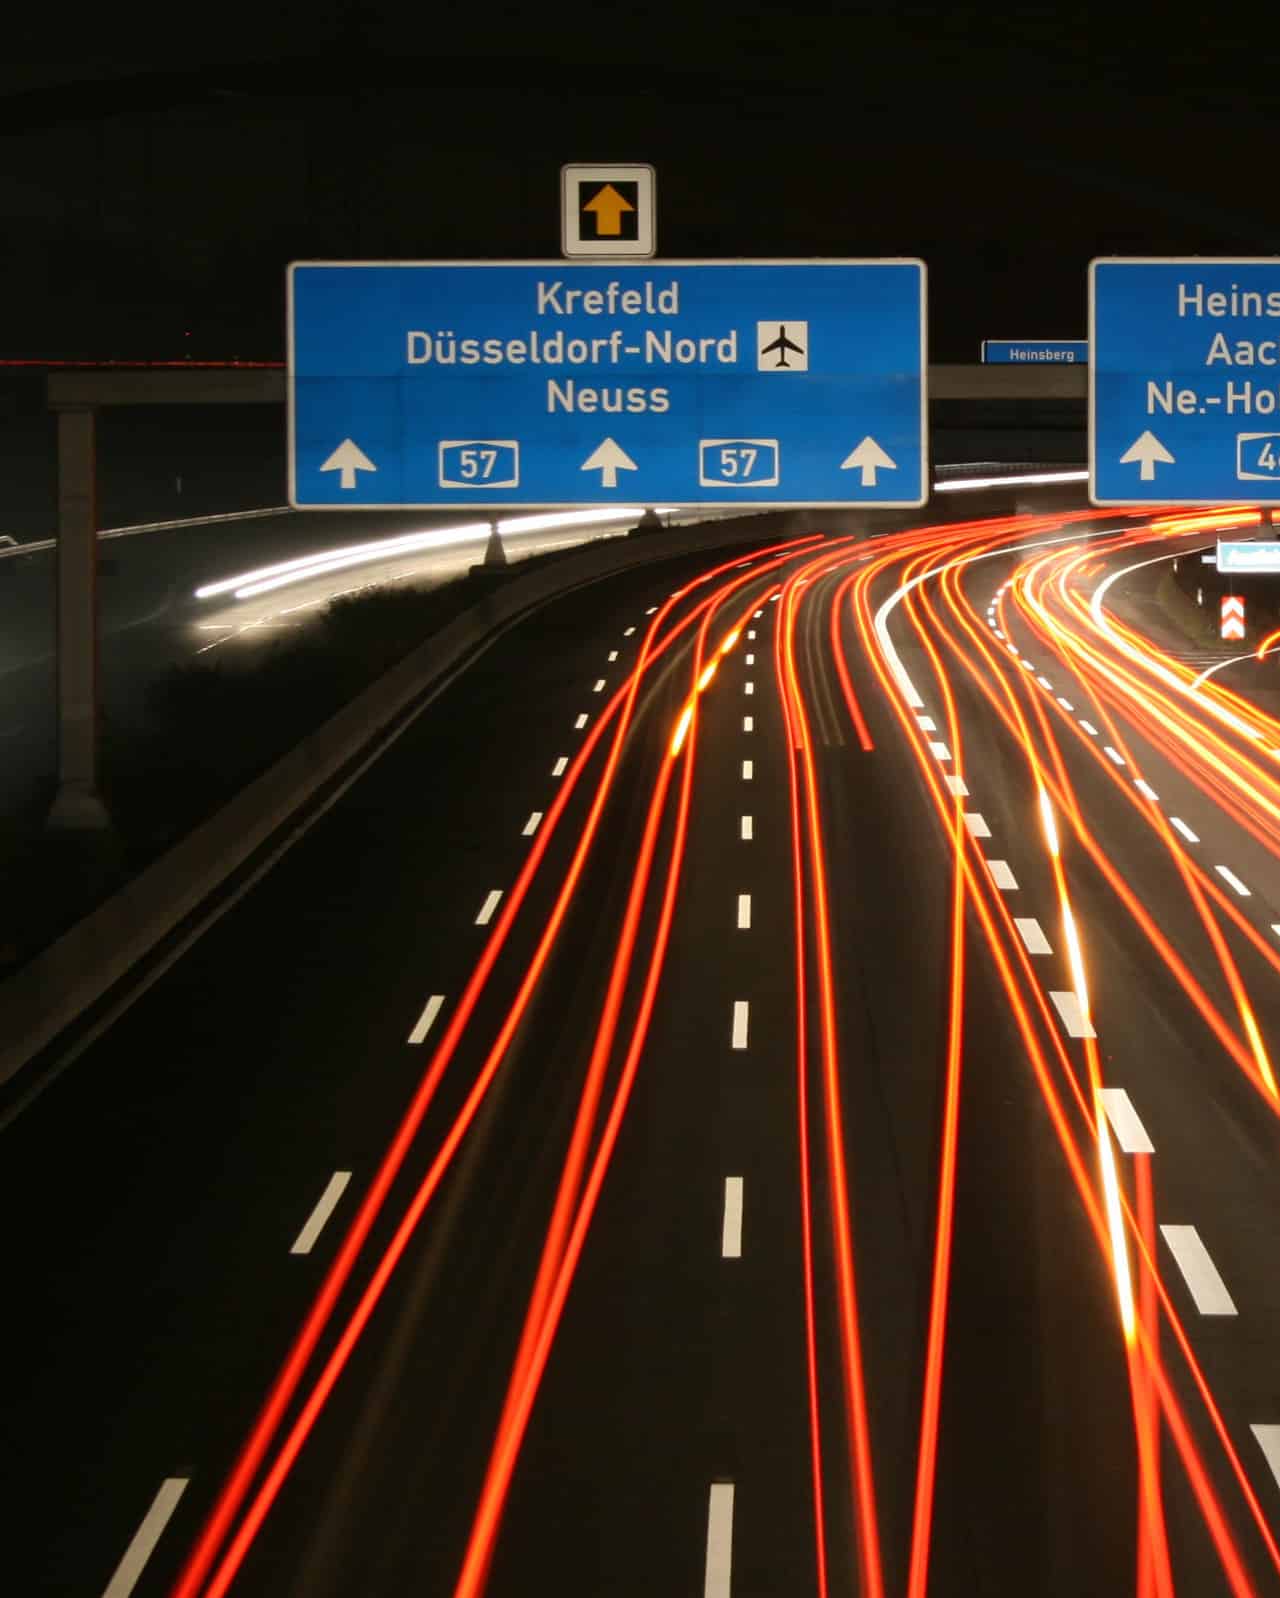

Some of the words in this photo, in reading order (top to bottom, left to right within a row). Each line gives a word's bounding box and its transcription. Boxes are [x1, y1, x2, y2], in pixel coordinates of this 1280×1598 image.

[537, 281, 679, 315] Krefeld
[407, 329, 738, 365] Düsseldorf-Nord
[1009, 348, 1075, 363] Heinsberg
[547, 379, 670, 413] Neuss
[460, 450, 497, 479] 57
[721, 449, 757, 478] 57
